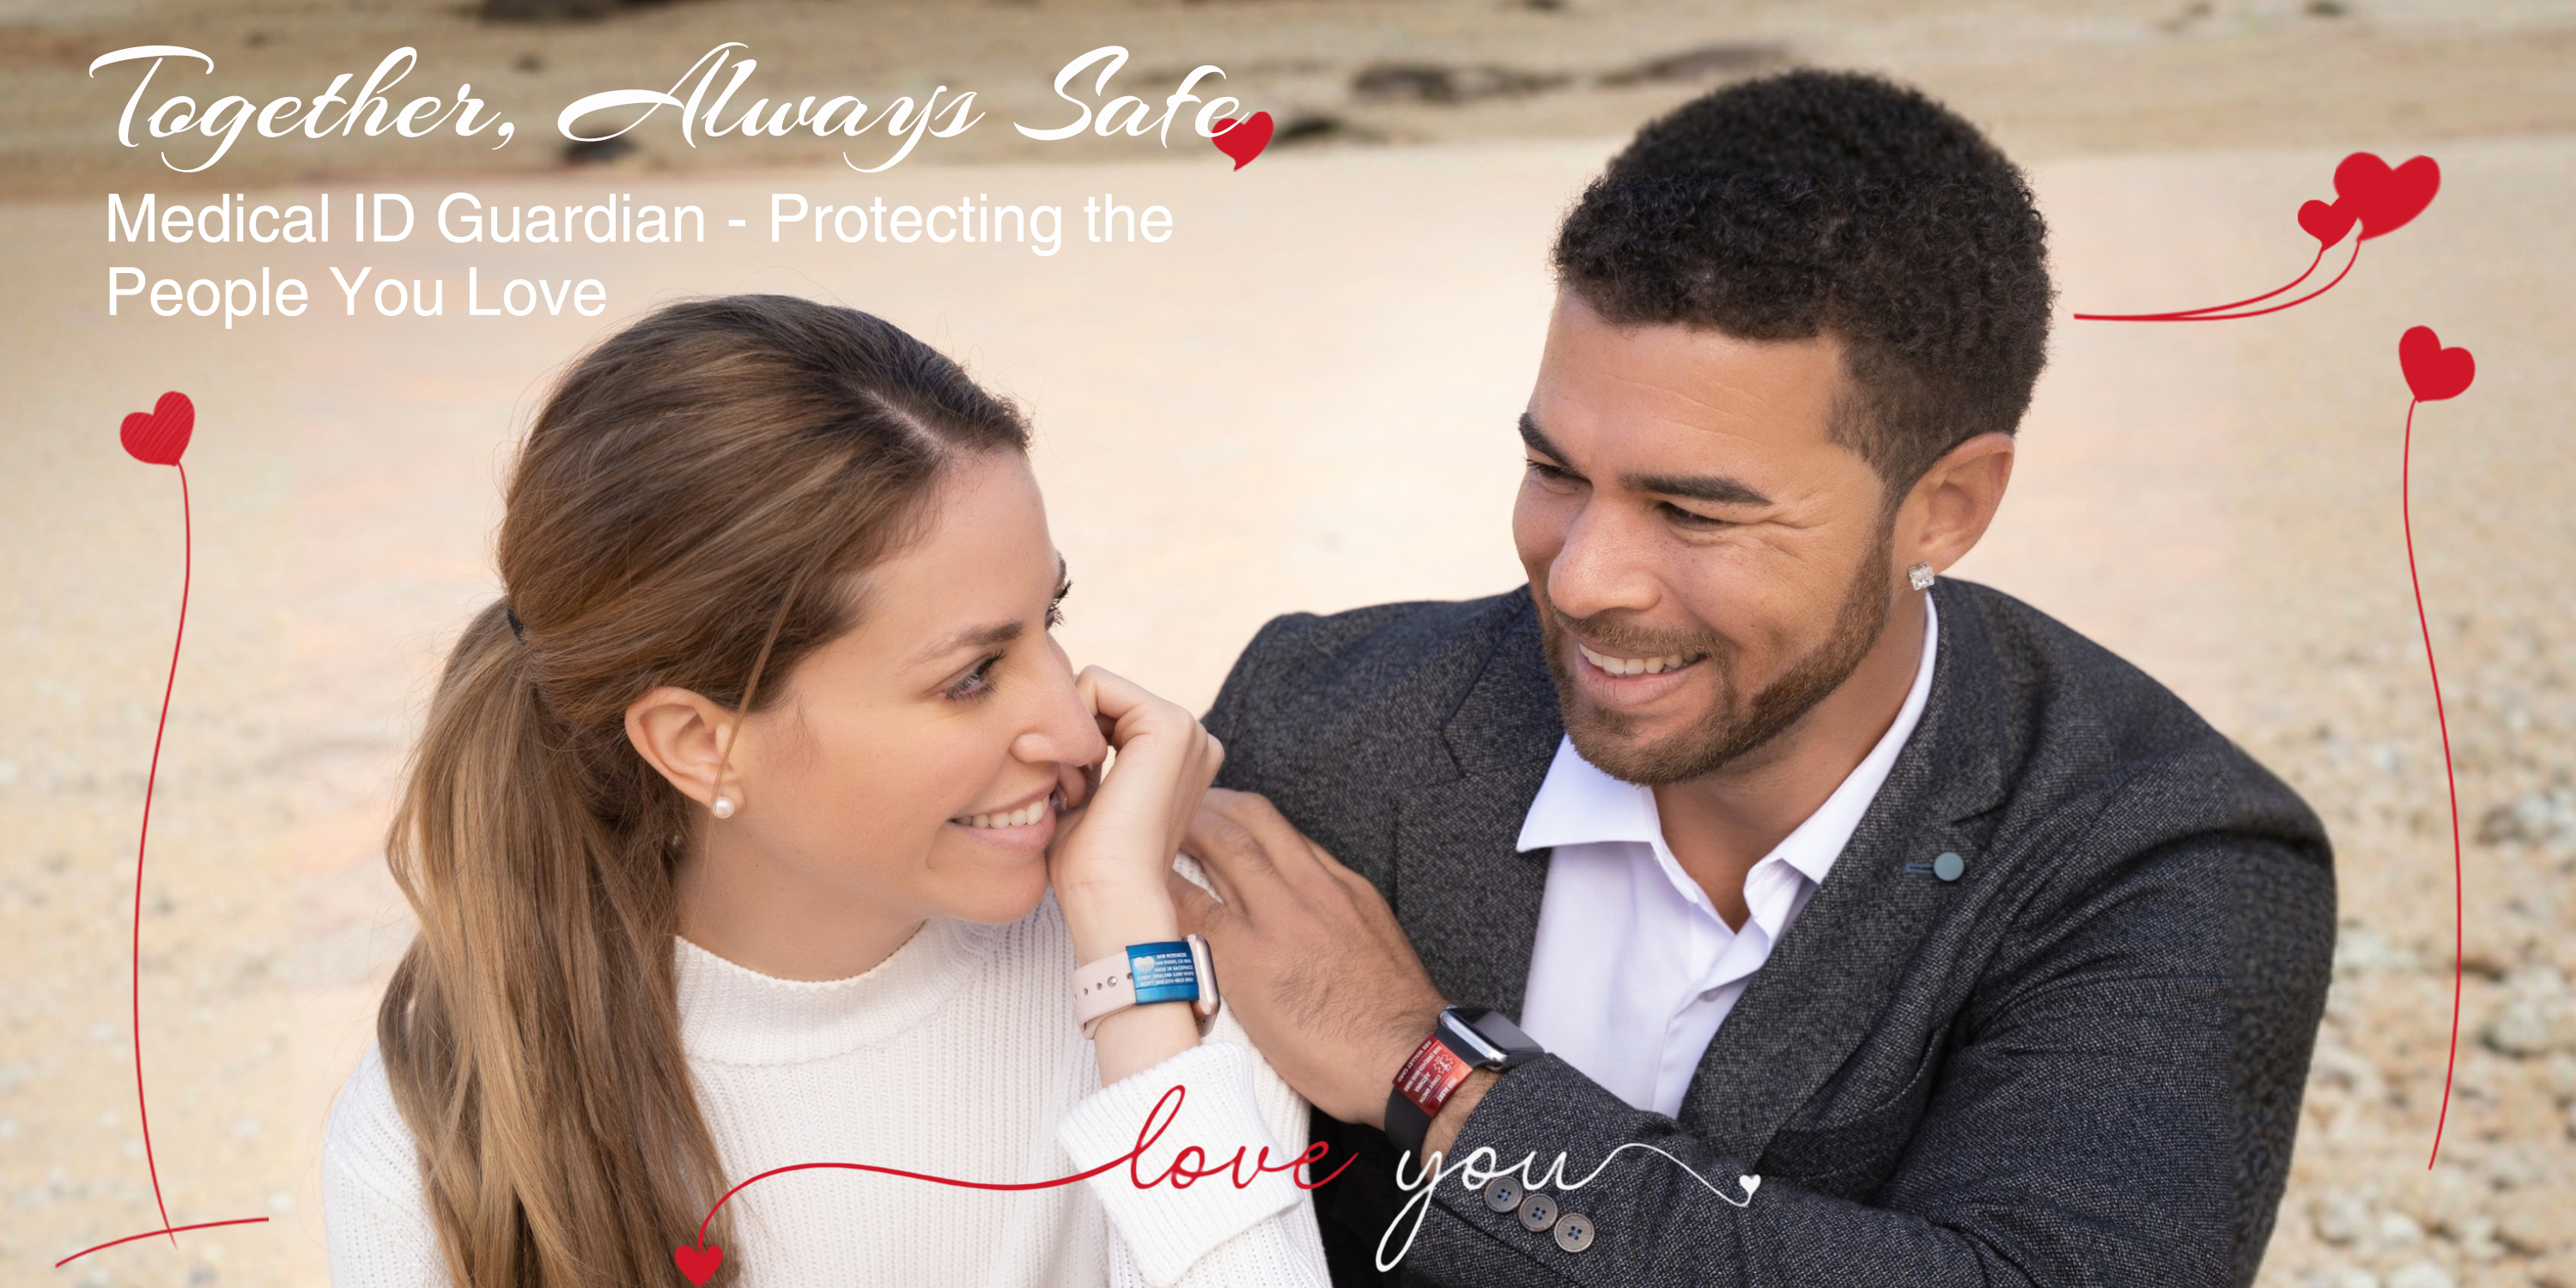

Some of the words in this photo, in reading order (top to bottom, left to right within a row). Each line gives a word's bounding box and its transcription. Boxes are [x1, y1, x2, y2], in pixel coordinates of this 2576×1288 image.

[1407, 1049, 1424, 1070] WALLET
[1397, 1068, 1408, 1082] CARD
[1414, 1071, 1431, 1093] ASTHMA
[1437, 1086, 1449, 1102] ALERT
